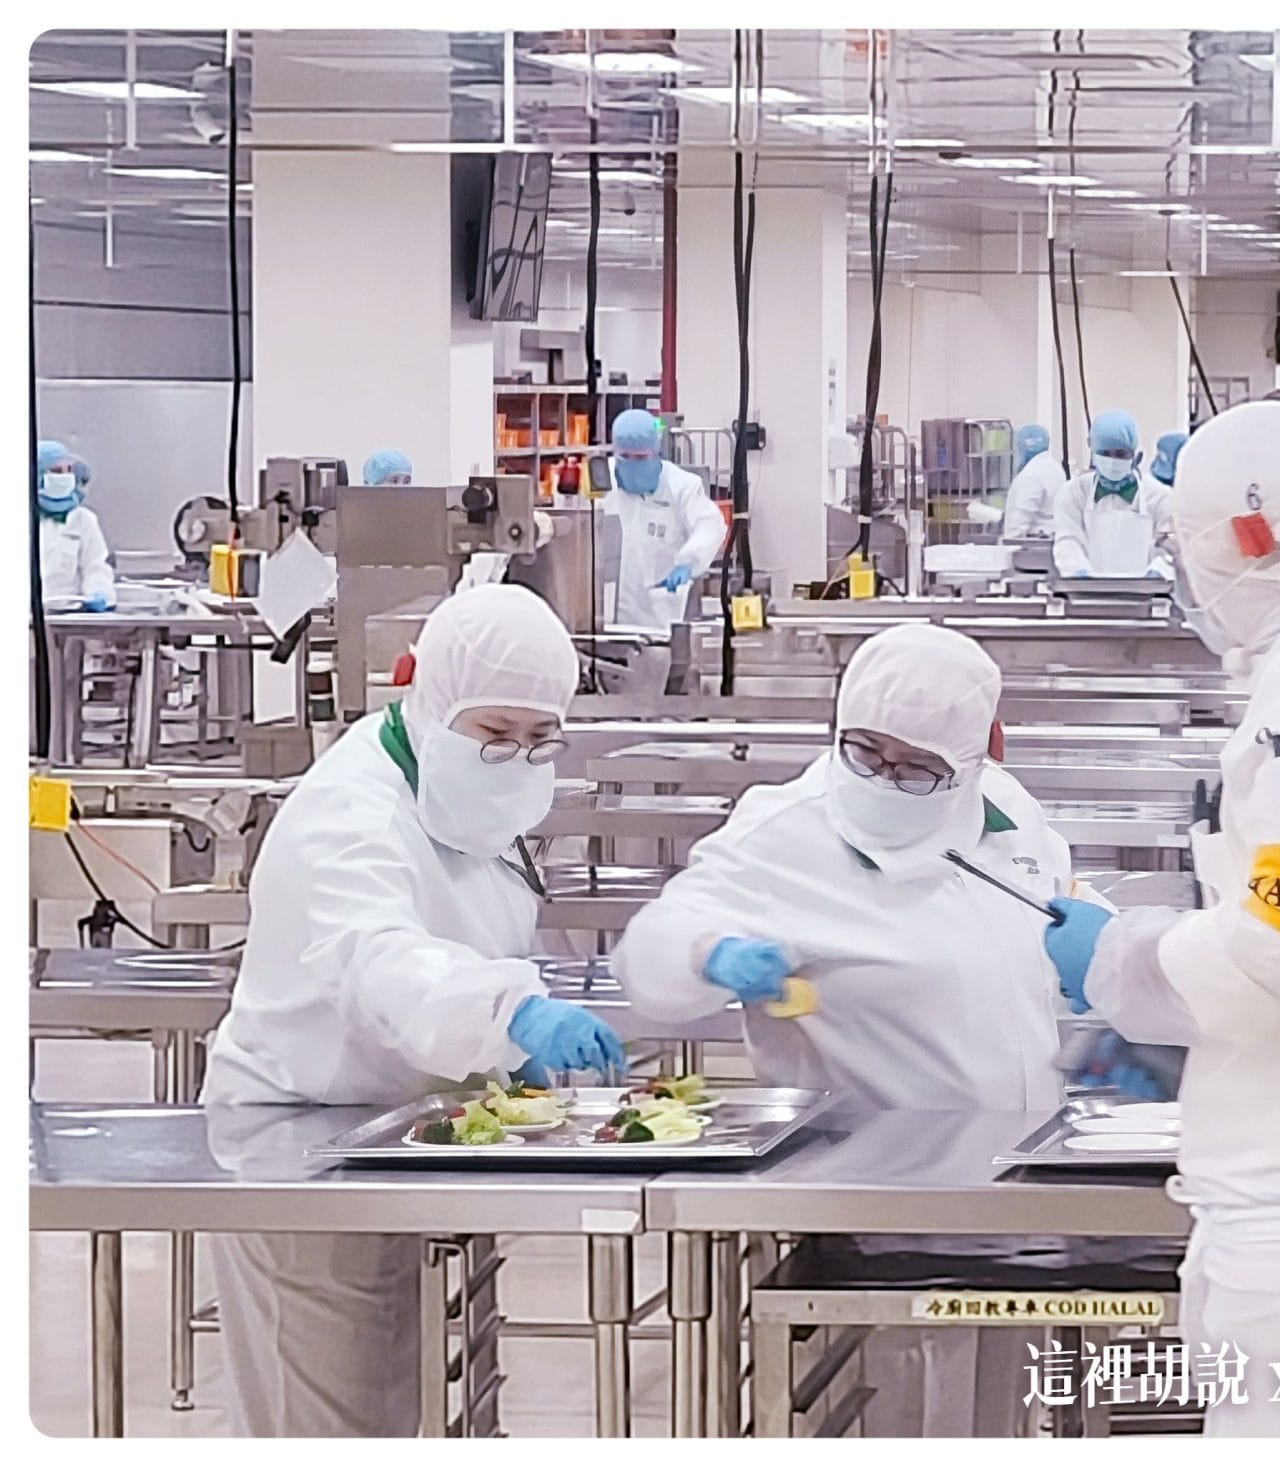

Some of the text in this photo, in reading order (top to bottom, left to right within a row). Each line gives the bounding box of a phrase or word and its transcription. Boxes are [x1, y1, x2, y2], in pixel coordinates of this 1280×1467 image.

[1246, 482, 1263, 511] 6
[1044, 1301, 1087, 1316] COD
[1092, 1301, 1160, 1316] HALAL
